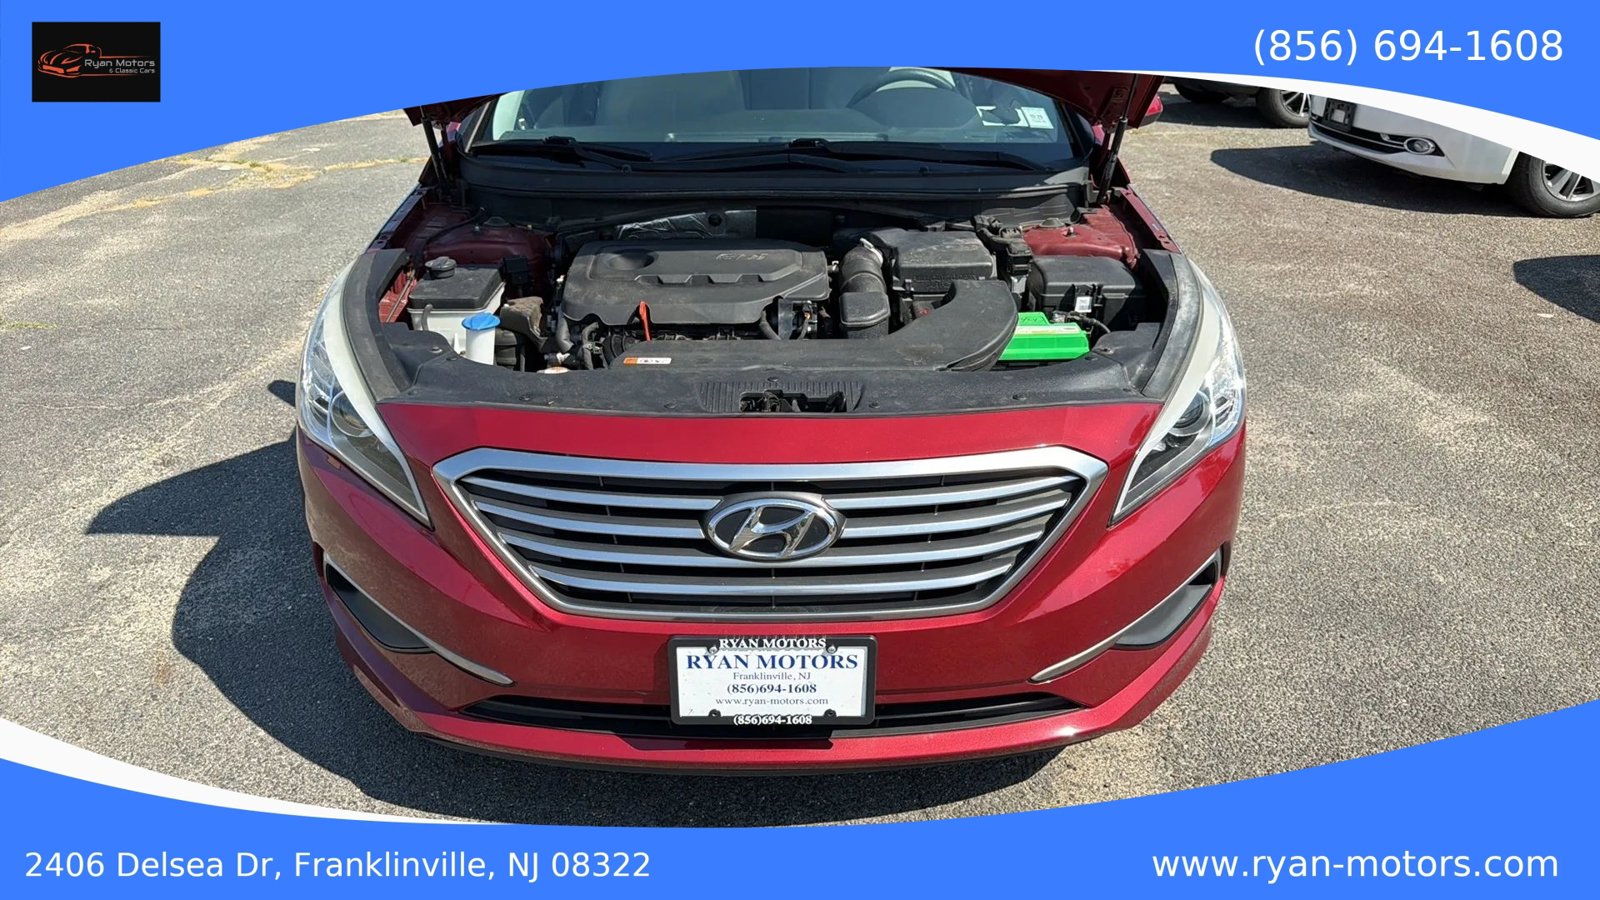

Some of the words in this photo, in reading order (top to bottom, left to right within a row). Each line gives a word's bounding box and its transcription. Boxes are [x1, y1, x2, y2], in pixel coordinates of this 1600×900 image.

[719, 638, 759, 649] RYAN
[763, 637, 827, 648] MOTORS
[686, 654, 749, 669] RYAN
[756, 654, 858, 669] MOTORS
[733, 672, 796, 681] Franklinville,
[798, 672, 811, 681] NJ
[727, 683, 817, 695] (856)694-1608
[715, 697, 829, 707] www.ryan-motors.com
[733, 714, 813, 725] (856)694-1608
